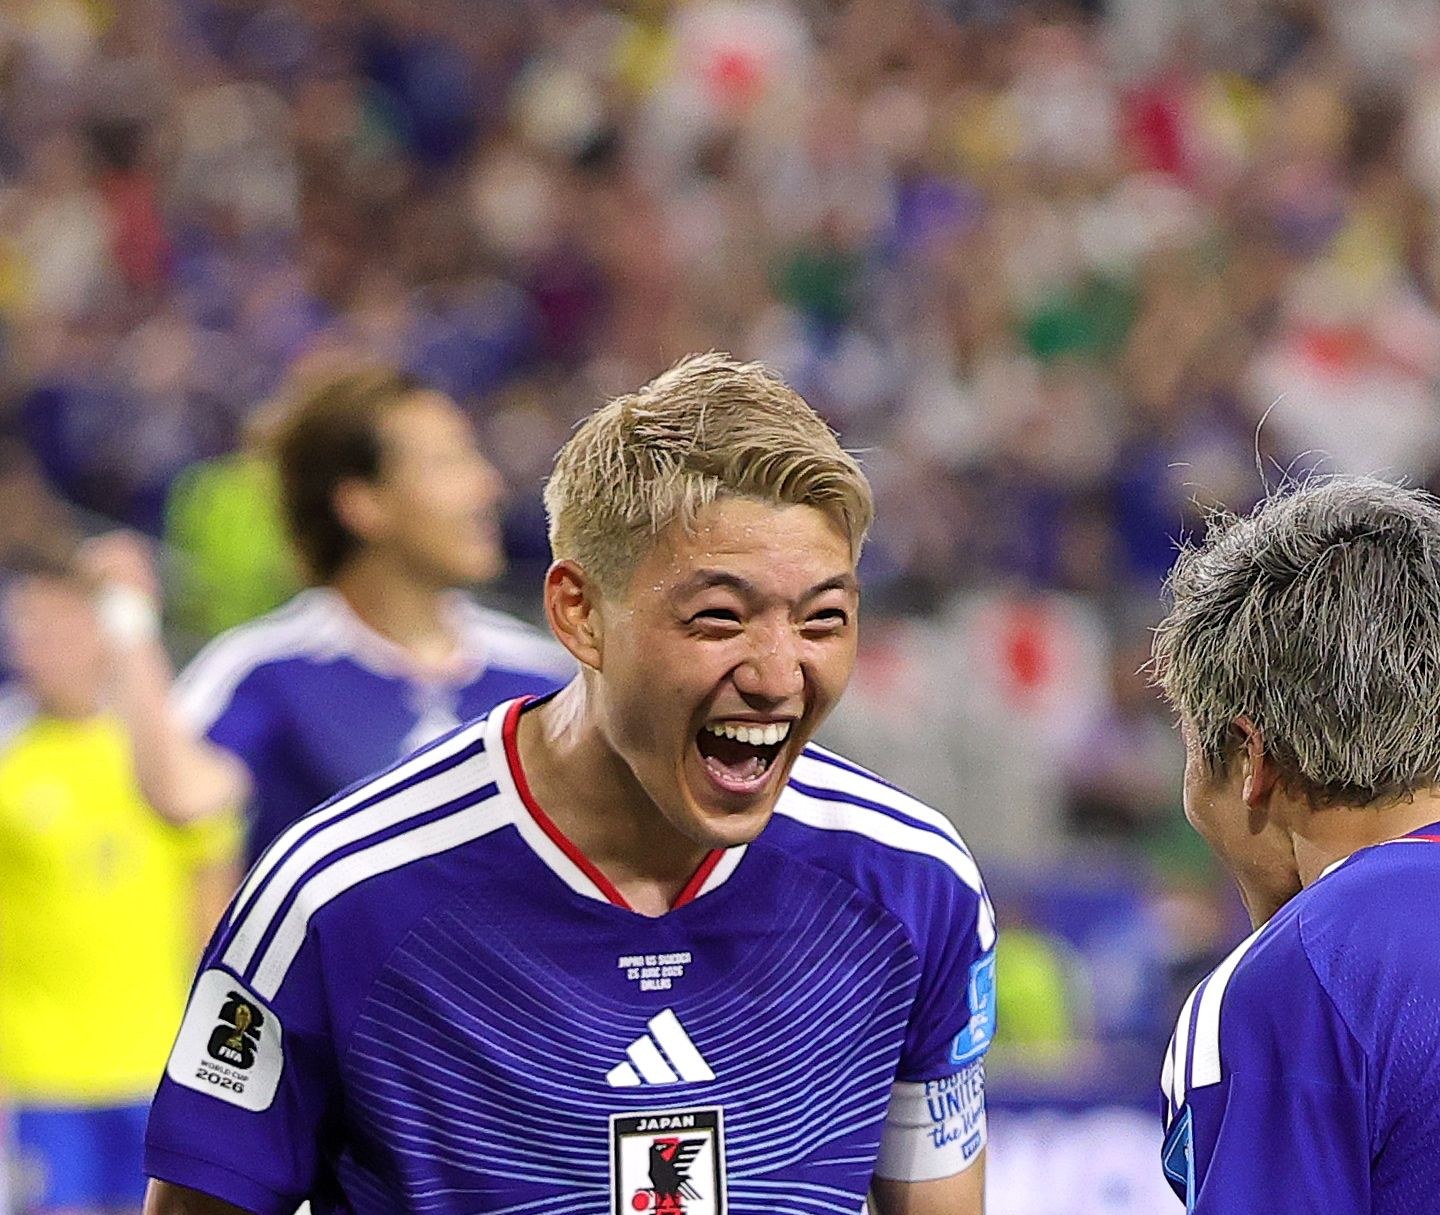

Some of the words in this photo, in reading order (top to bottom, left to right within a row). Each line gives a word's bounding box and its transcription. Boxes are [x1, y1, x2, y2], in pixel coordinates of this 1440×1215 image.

[218, 1045, 242, 1063] FIFA
[201, 1060, 231, 1075] WORLD
[232, 1071, 249, 1081] CUP
[196, 1068, 244, 1093] 2026
[637, 1115, 694, 1131] JAPAN
